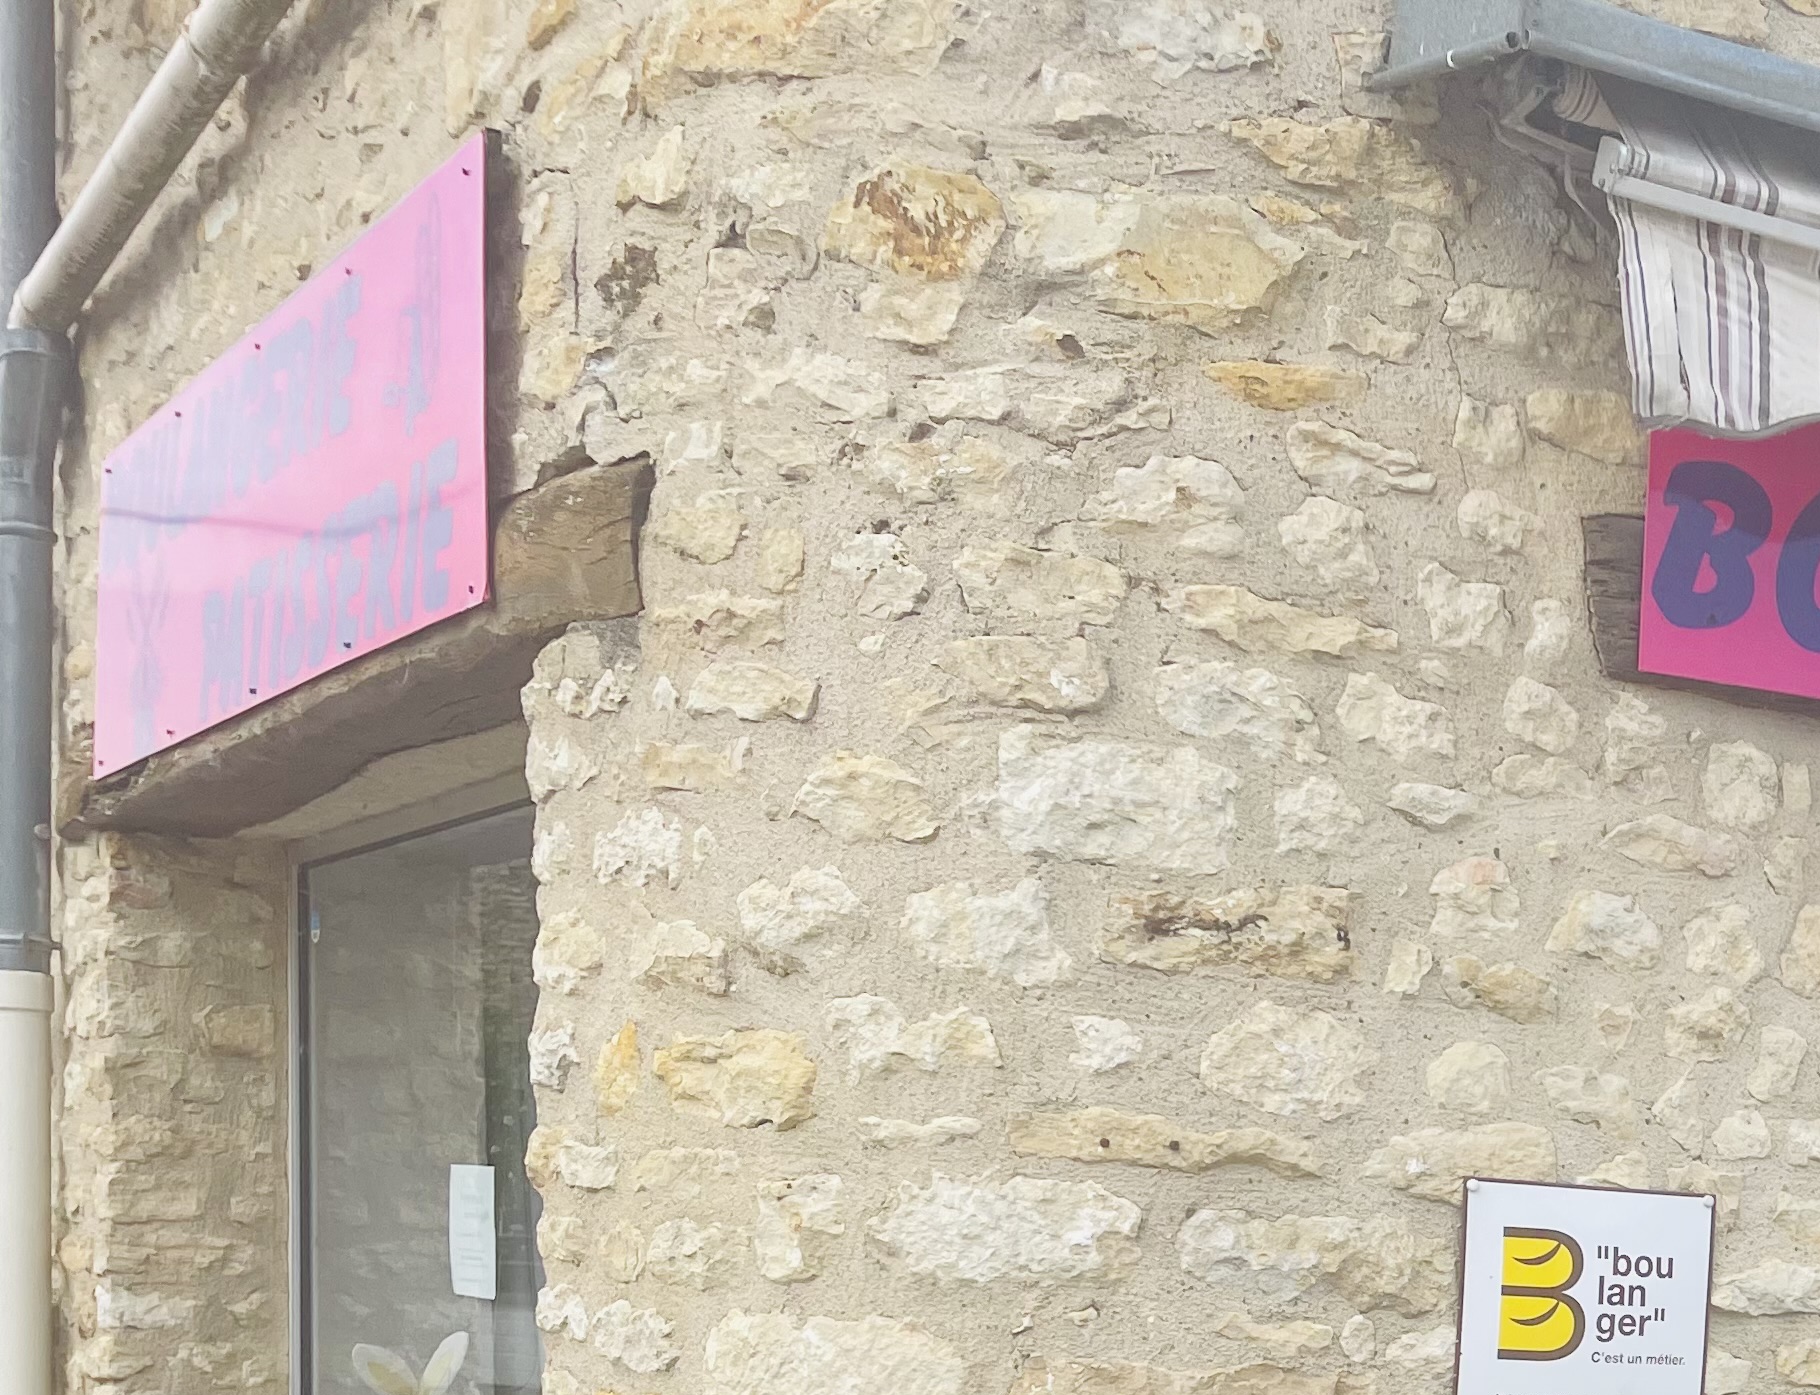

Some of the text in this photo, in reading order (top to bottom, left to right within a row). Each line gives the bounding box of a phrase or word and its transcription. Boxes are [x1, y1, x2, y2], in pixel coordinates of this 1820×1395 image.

[1597, 1244, 1674, 1279] "bou
[1597, 1275, 1646, 1307] lan
[1596, 1307, 1665, 1342] ger"
[1591, 1351, 1624, 1364] C'est
[1627, 1354, 1642, 1365] un
